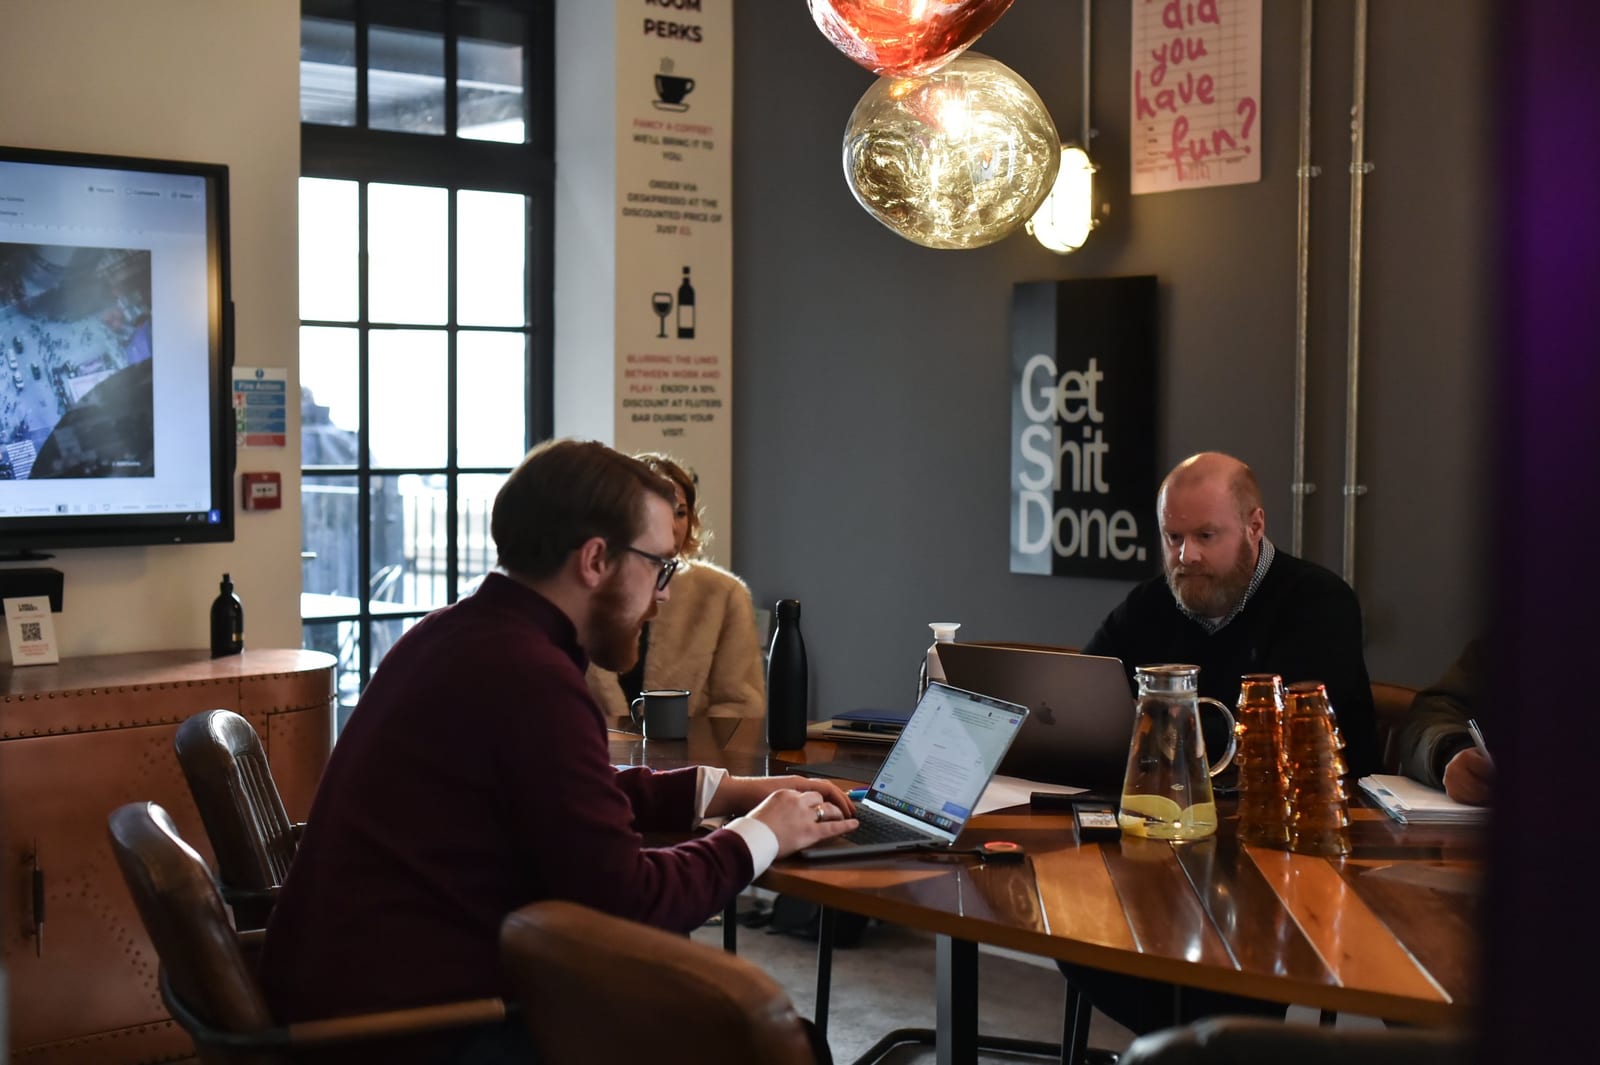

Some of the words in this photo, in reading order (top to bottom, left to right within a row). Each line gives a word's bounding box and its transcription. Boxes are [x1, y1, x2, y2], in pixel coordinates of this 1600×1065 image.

[645, 0, 701, 12] OM
[643, 18, 702, 43] PERKS
[1150, 37, 1208, 87] you
[1135, 70, 1215, 120] have
[661, 136, 689, 148] BRING
[701, 140, 714, 151] TO
[648, 180, 680, 190] ORDER
[682, 183, 698, 192] VIA
[688, 198, 699, 207] AT
[700, 198, 718, 208] THE
[622, 207, 681, 220] DISCOUNTED
[683, 211, 708, 222] PRICE
[709, 214, 722, 223] OF
[656, 224, 678, 234] JUST
[626, 354, 673, 365] BLURRING
[675, 355, 691, 365] THE
[693, 355, 719, 366] LINES
[624, 369, 670, 379] BETWEEN
[671, 370, 699, 379] WORK
[700, 370, 721, 379] AND
[238, 382, 254, 390] Fire
[256, 382, 281, 390] Action
[629, 384, 653, 393] PLAY
[660, 384, 690, 393] ENJOY
[1021, 354, 1104, 423] Get
[622, 398, 669, 408] DISCOUNT
[671, 399, 683, 408] AT
[631, 413, 651, 423] BAR
[652, 413, 688, 423] DURING
[689, 413, 714, 422] YOUR
[1019, 424, 1109, 493] Shit
[1018, 490, 1147, 561] Done.
